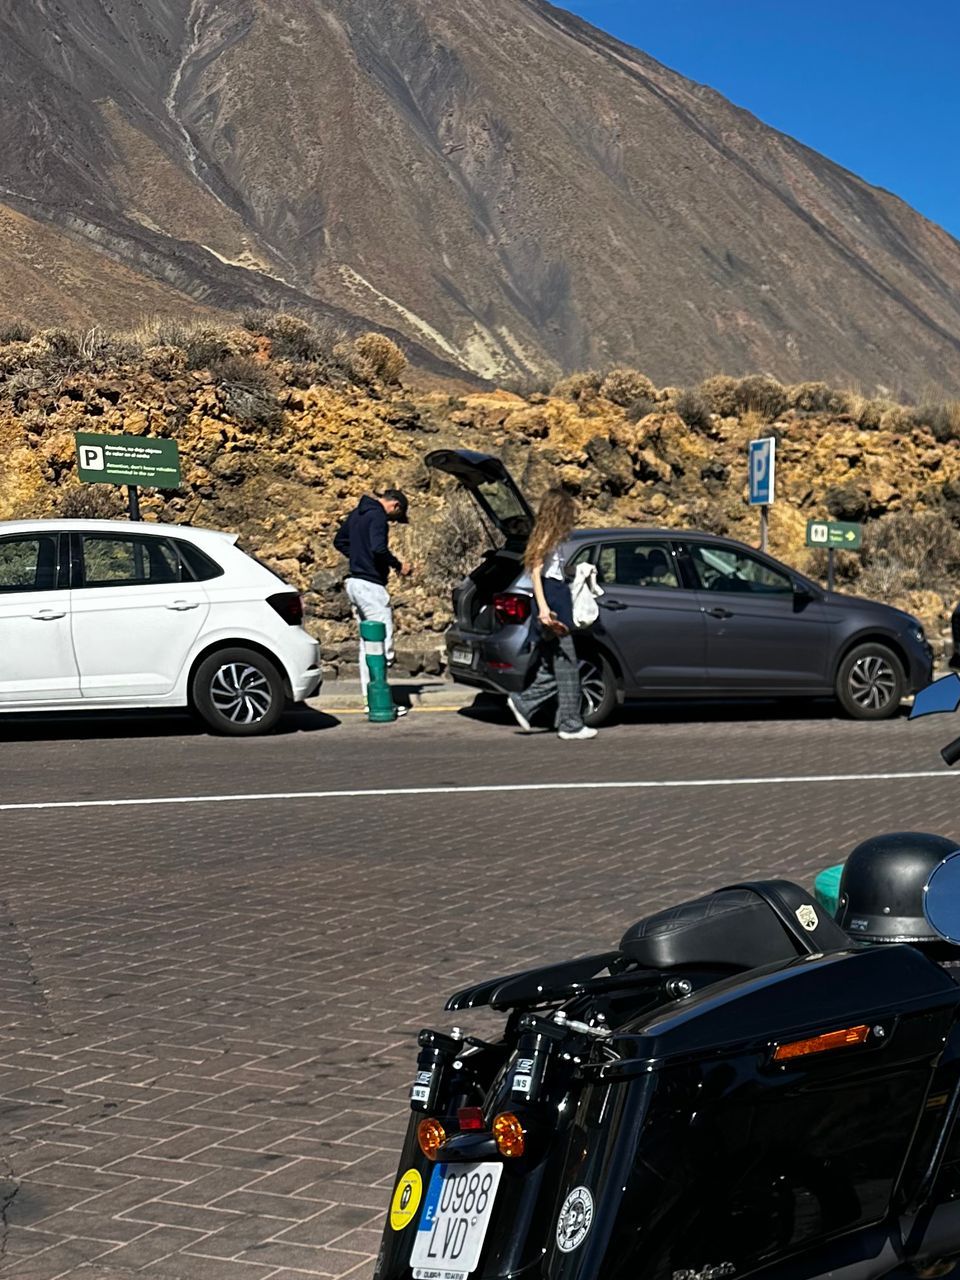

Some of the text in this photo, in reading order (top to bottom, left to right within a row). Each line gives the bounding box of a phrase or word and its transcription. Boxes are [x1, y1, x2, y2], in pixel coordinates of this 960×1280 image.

[84, 449, 98, 467] P
[440, 1173, 493, 1214] 0988
[425, 1206, 434, 1220] E
[427, 1217, 468, 1259] LVD
